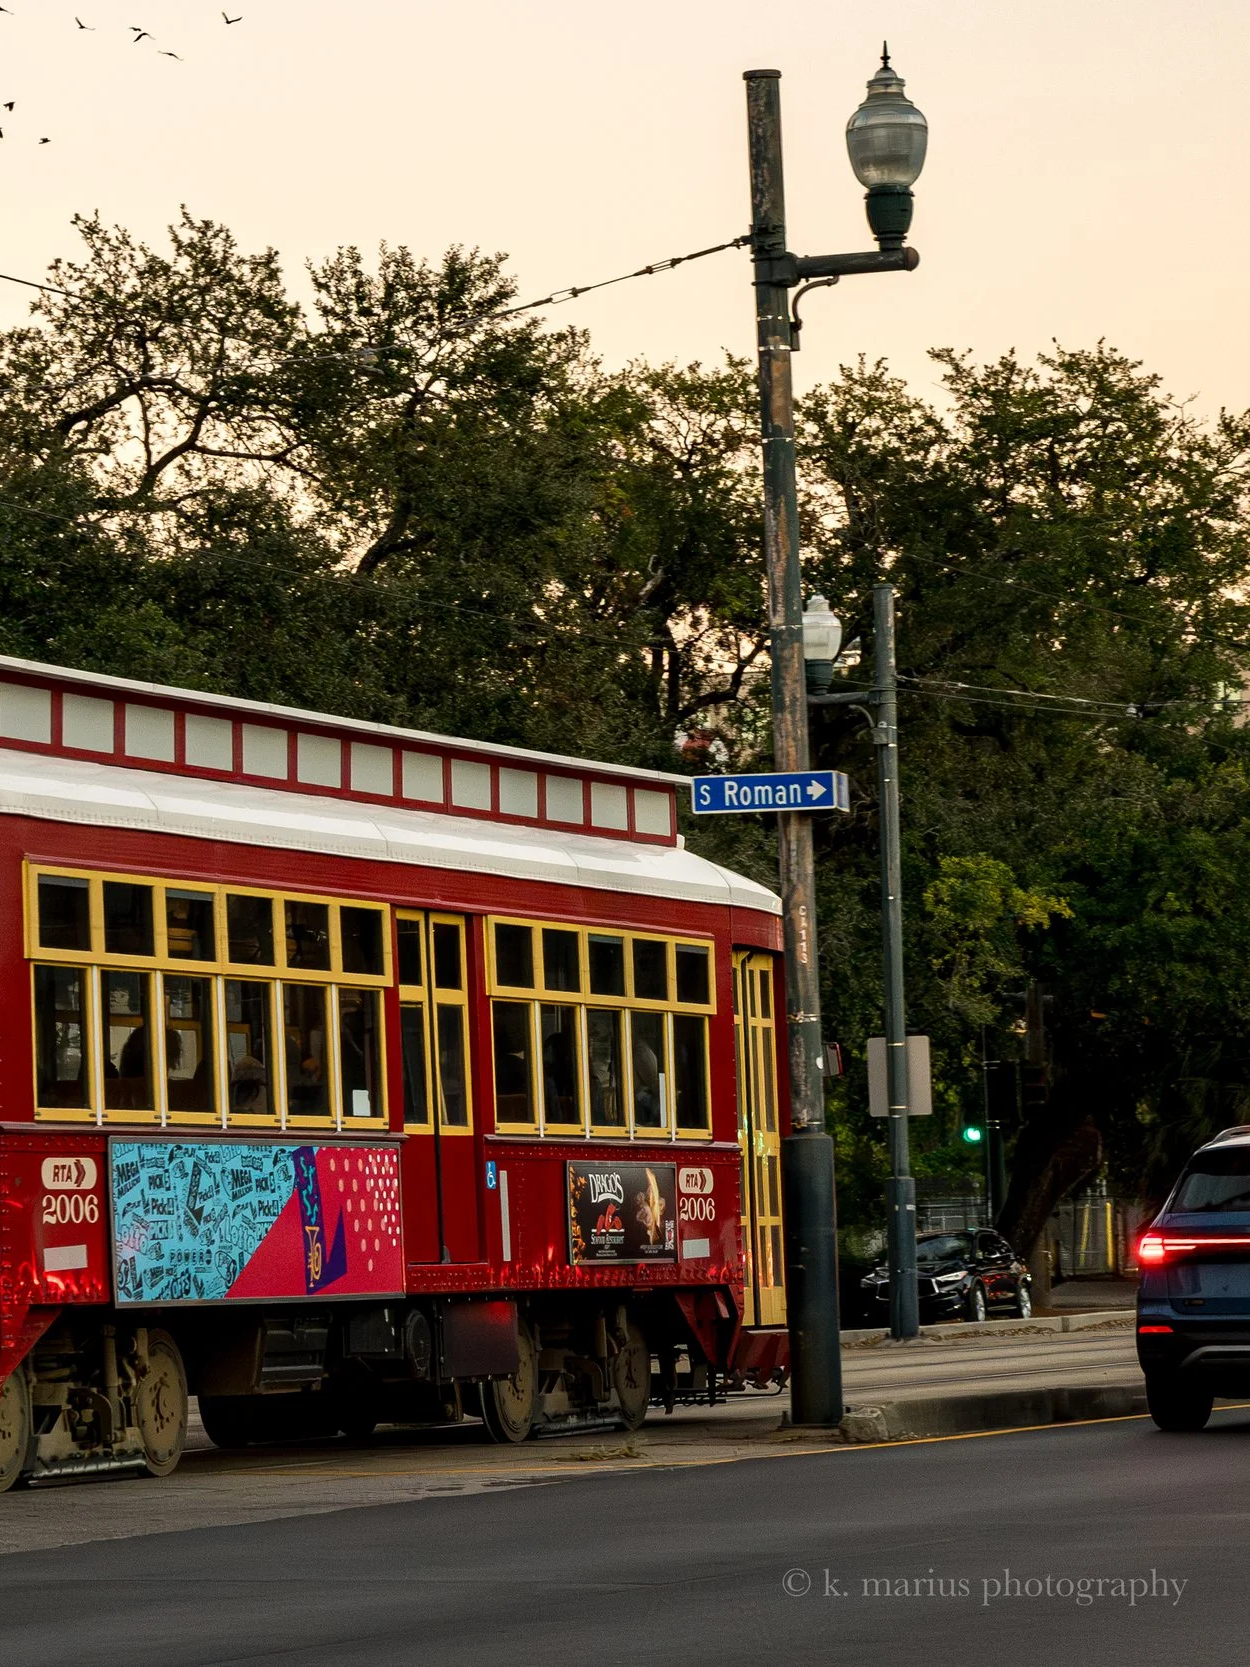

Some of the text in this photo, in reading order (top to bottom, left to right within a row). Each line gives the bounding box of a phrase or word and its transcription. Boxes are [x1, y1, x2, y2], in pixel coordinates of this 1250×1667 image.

[699, 780, 801, 807] S Roman
[53, 1164, 73, 1183] RTA
[685, 1173, 699, 1189] RTA
[42, 1194, 99, 1225] 2006
[679, 1197, 716, 1222] 2006
